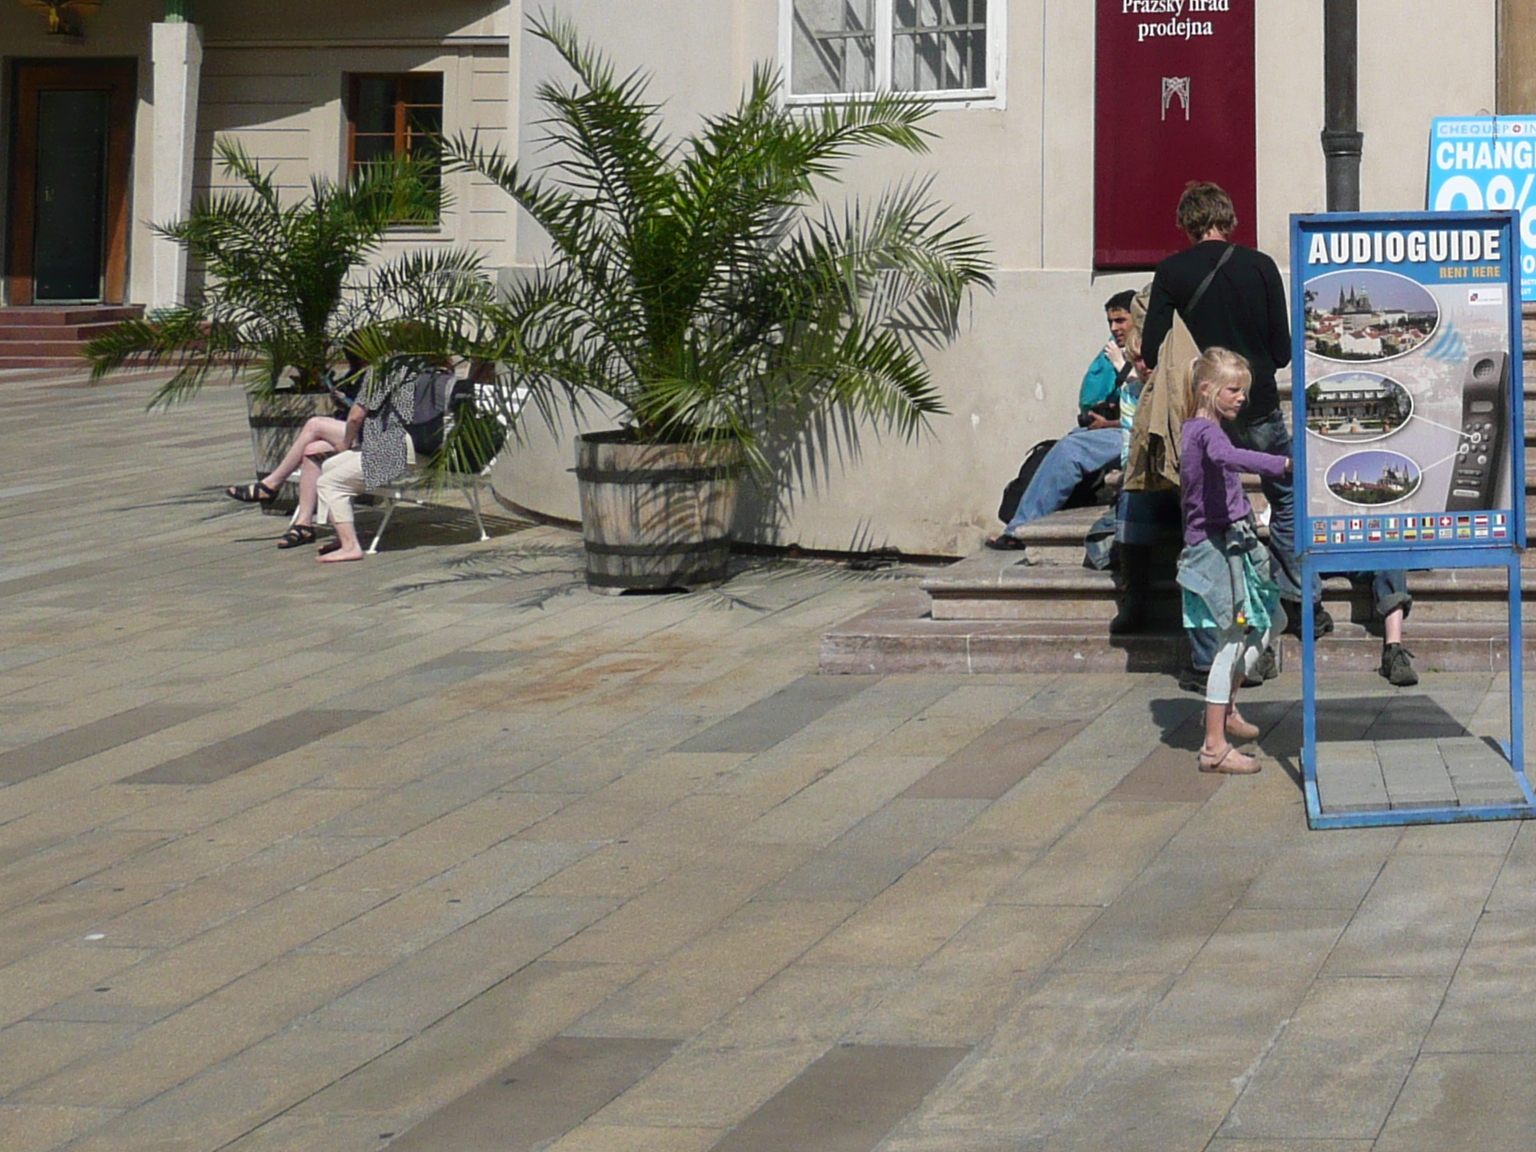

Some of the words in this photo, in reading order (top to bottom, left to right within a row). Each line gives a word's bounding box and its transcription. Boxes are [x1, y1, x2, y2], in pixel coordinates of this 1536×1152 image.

[1138, 18, 1213, 41] prodejna
[1308, 230, 1501, 264] AUDIOGUIDE
[1440, 266, 1468, 278] RENT
[1472, 265, 1500, 278] HERE
